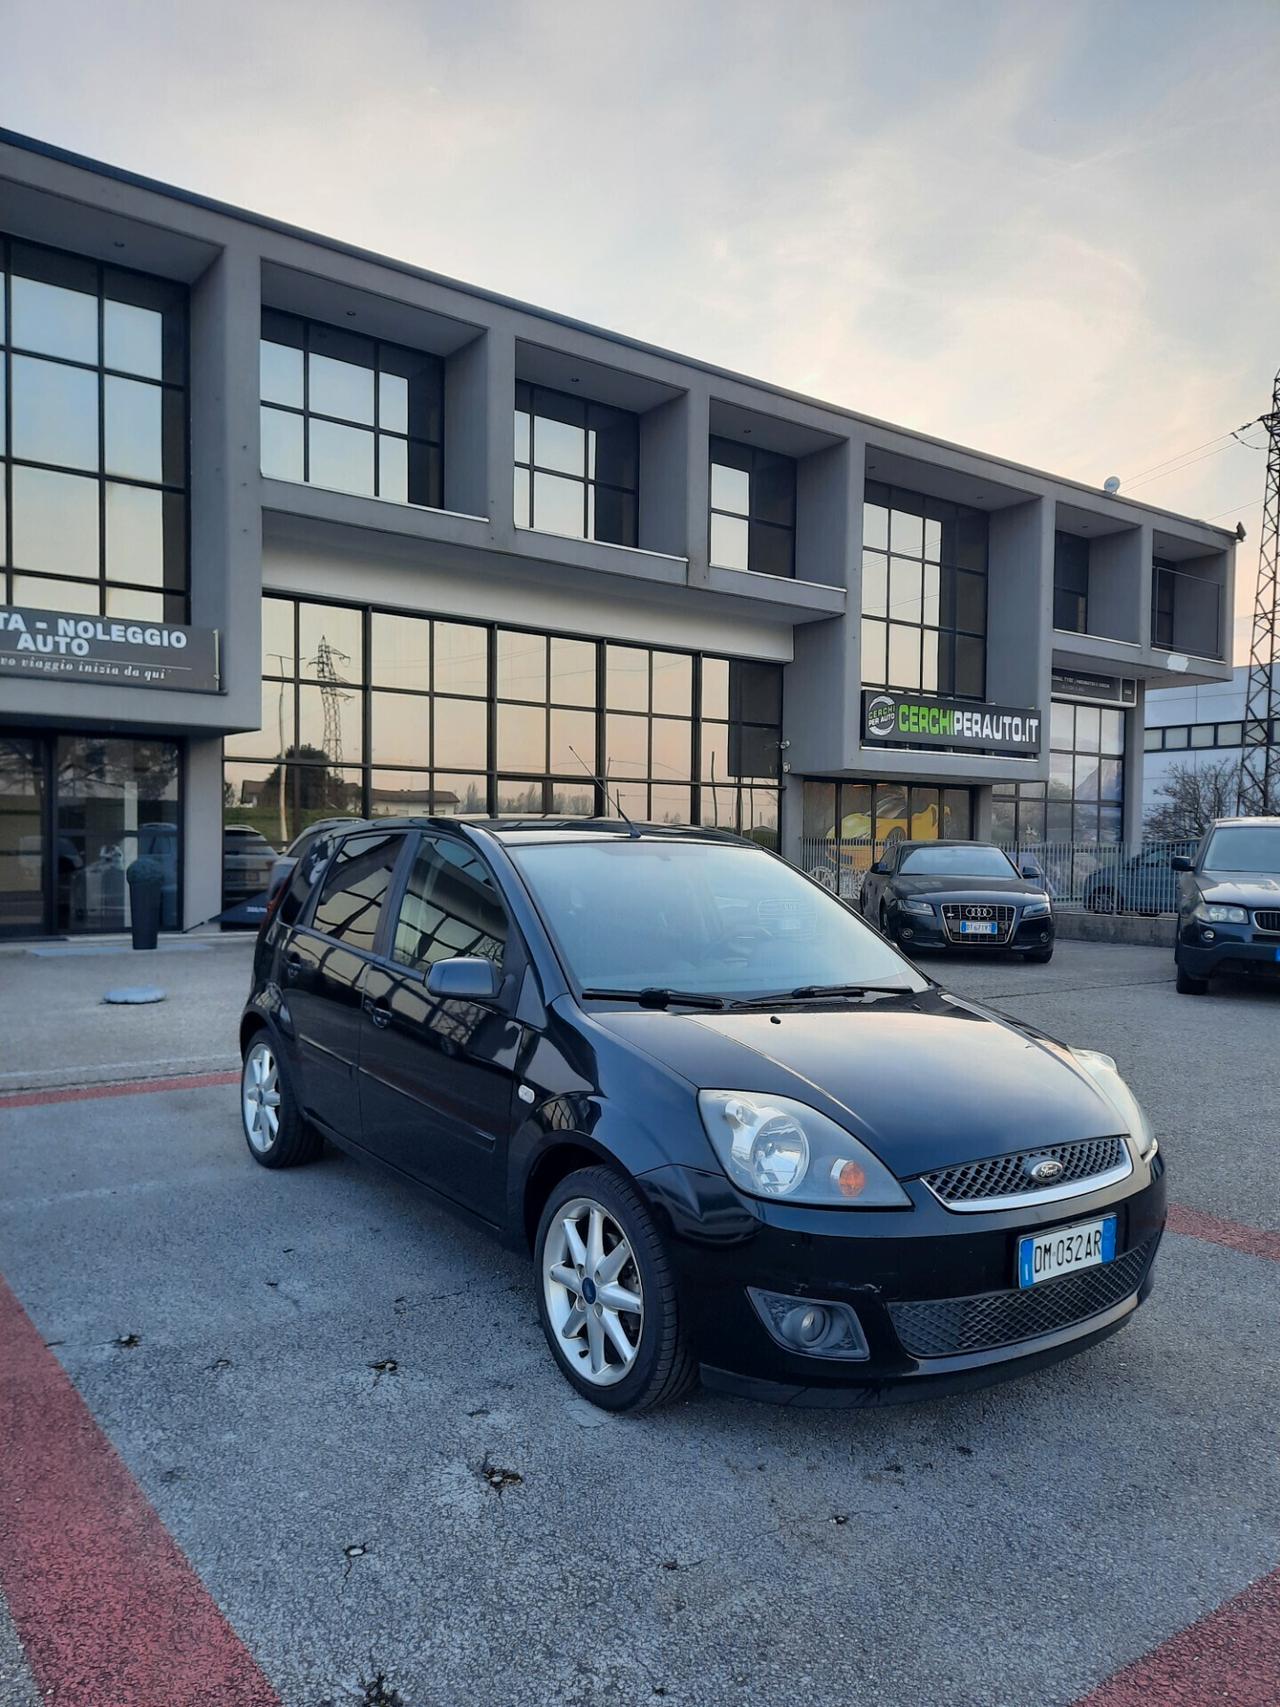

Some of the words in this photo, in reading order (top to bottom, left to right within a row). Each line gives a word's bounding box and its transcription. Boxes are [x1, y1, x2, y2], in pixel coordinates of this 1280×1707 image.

[57, 618, 187, 648] NOLEGGIO
[17, 633, 90, 656] AUTO
[21, 657, 73, 673] viaggio
[79, 661, 119, 675] inizia
[124, 665, 140, 677] da
[868, 705, 895, 719] CERCHI
[868, 717, 879, 727] PER
[880, 713, 895, 723] AUTO
[898, 704, 1039, 743] CERCHIPERAUTO.IT
[1040, 1164, 1058, 1178] Ford
